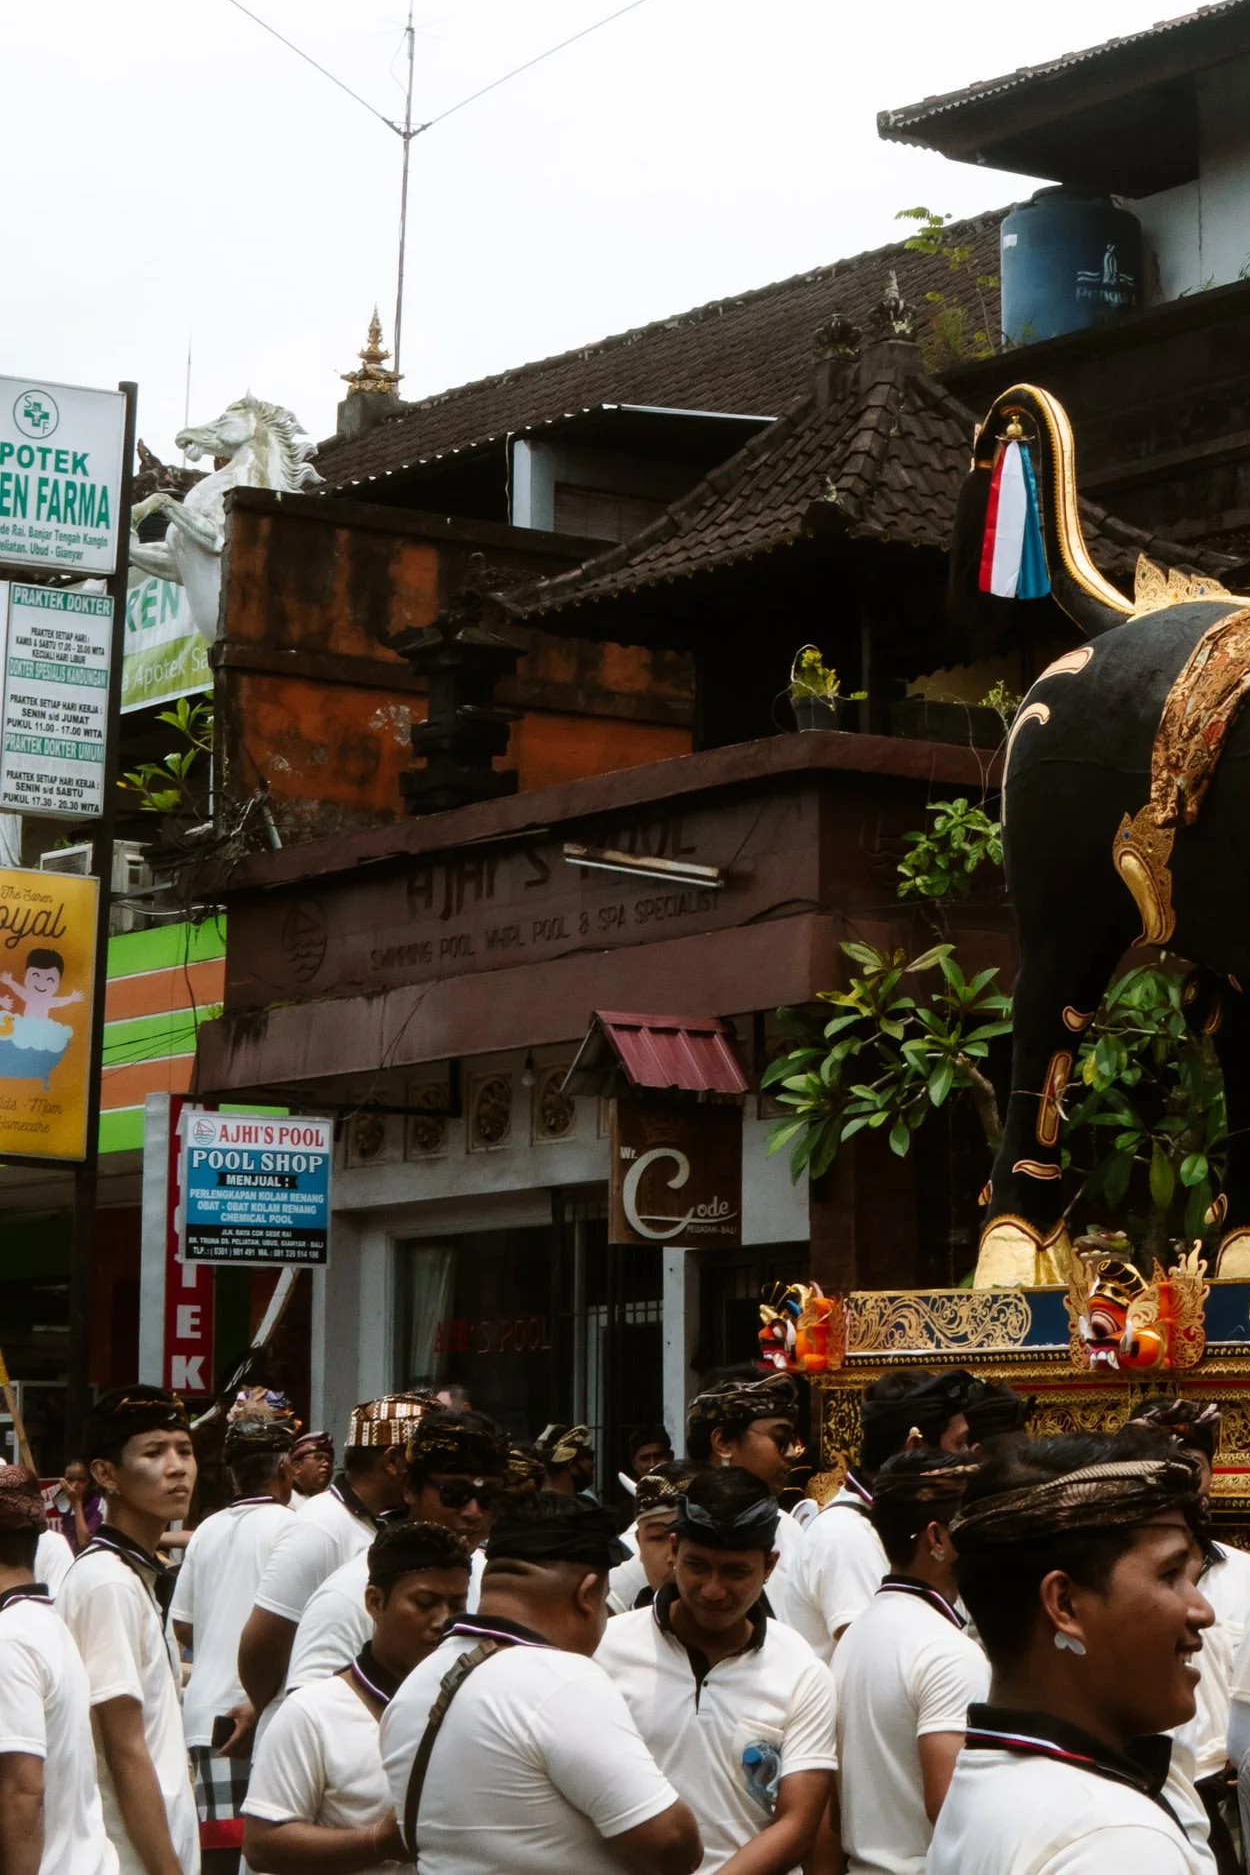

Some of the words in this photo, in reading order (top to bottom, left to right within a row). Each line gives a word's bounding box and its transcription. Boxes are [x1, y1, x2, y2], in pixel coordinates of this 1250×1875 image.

[36, 476, 110, 530] FARMA
[28, 526, 52, 542] Banjar
[55, 529, 81, 545] Tengah
[83, 533, 108, 549] Kangin
[30, 542, 49, 556] Ubud
[55, 546, 84, 562] Gianyar
[14, 586, 64, 610] PRAKTEK
[66, 592, 111, 616] DOKTER
[31, 627, 55, 639] PRAKTEK
[55, 630, 73, 641] SETIAP
[74, 633, 87, 643] HARI
[16, 636, 33, 646] KAMIS
[39, 639, 57, 650] SABTU
[92, 647, 105, 656] WITA
[32, 649, 55, 661] KECUALI
[55, 652, 69, 663] HARI
[70, 654, 86, 664] LIBUR
[9, 659, 35, 678] DOKTER
[35, 661, 67, 683] SPESIALIS
[66, 665, 107, 688] KANDUNGAN
[133, 652, 186, 693] Apotek
[10, 694, 38, 706] PRAKTEK
[40, 698, 60, 709] SETIAP
[62, 701, 77, 712] HARI
[79, 704, 98, 715] KERJA
[21, 707, 46, 720] SENIN
[48, 711, 59, 720] s/d
[62, 714, 90, 726] JUMAT
[6, 717, 32, 730] PUKUL
[35, 721, 55, 733] 11.00
[61, 725, 81, 737] 17.00
[83, 728, 103, 739] WITA
[5, 733, 43, 754] PRAKTEK
[43, 737, 77, 759] DOKTER
[78, 743, 104, 763] UMUM
[6, 770, 35, 782] PRAKTEK
[36, 773, 57, 785] SETIAP
[59, 777, 74, 787] HARI
[75, 779, 96, 790] KERJA
[15, 781, 40, 794] SENIN
[42, 785, 53, 794] s/d
[56, 786, 84, 798] SABTU
[3, 792, 29, 805] PUKUL
[32, 796, 52, 807] 17.30
[58, 799, 79, 811] 20.30
[80, 803, 100, 814] WITA
[1, 885, 22, 900] The
[439, 933, 476, 961] POOL
[532, 916, 571, 945] POOL
[598, 904, 626, 932] SPA
[635, 889, 720, 925] SPECIALIST
[219, 1124, 274, 1145] AJHI'S
[278, 1127, 324, 1148] POOL
[192, 1150, 255, 1171] POOL
[260, 1152, 323, 1174] SHOP
[620, 1146, 638, 1160] Wr.
[226, 1174, 281, 1188] MENJUAL
[189, 1188, 257, 1201] PERLENGKAPAN
[259, 1190, 288, 1202] KOLAM
[290, 1192, 324, 1204] RENANG
[198, 1200, 220, 1211] OBAT
[226, 1202, 249, 1212] OBAT
[251, 1203, 280, 1214] KOLAM
[282, 1204, 317, 1215] RENANG
[220, 1212, 267, 1224] CHEMICAL
[268, 1214, 294, 1225] POOL
[498, 1315, 553, 1353] POOL
